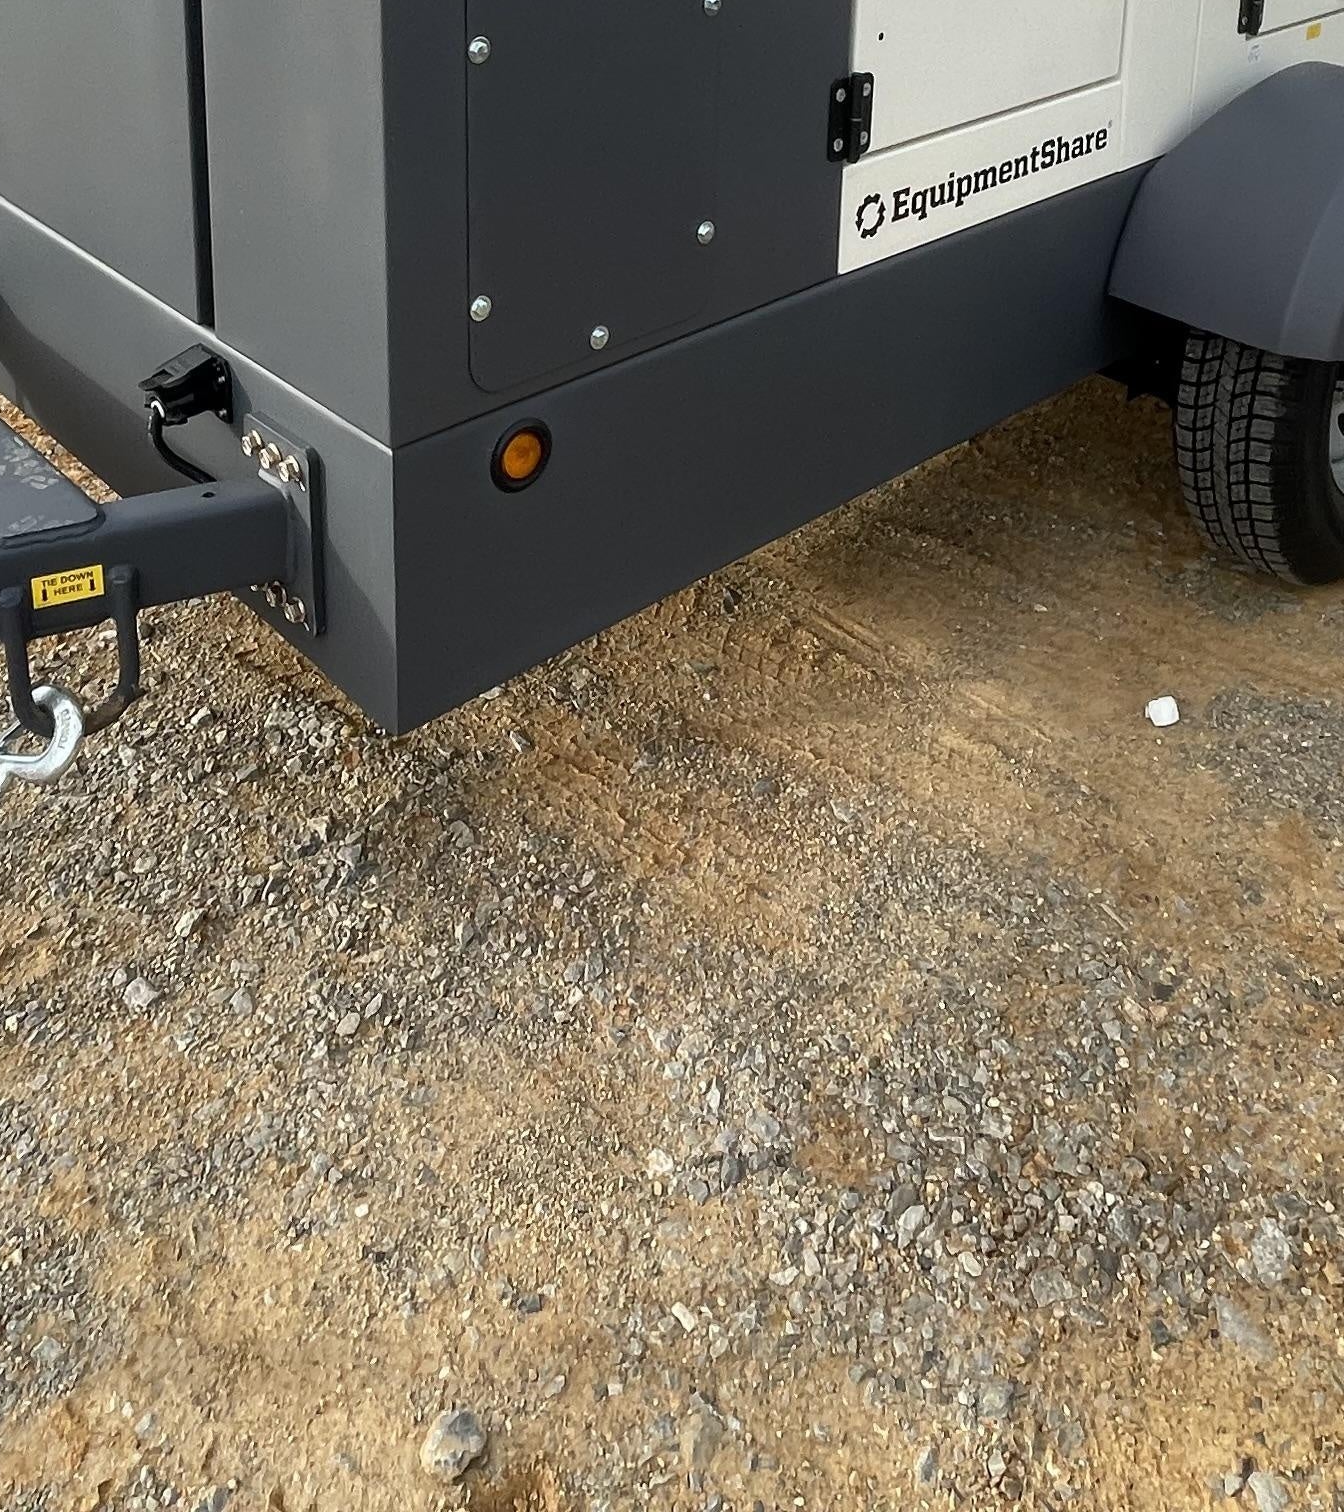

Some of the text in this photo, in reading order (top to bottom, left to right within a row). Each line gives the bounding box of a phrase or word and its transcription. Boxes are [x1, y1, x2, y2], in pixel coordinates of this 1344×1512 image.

[891, 127, 1109, 223] EquipmentShare
[41, 571, 94, 588] TIE DOWN
[54, 583, 84, 596] HERE
